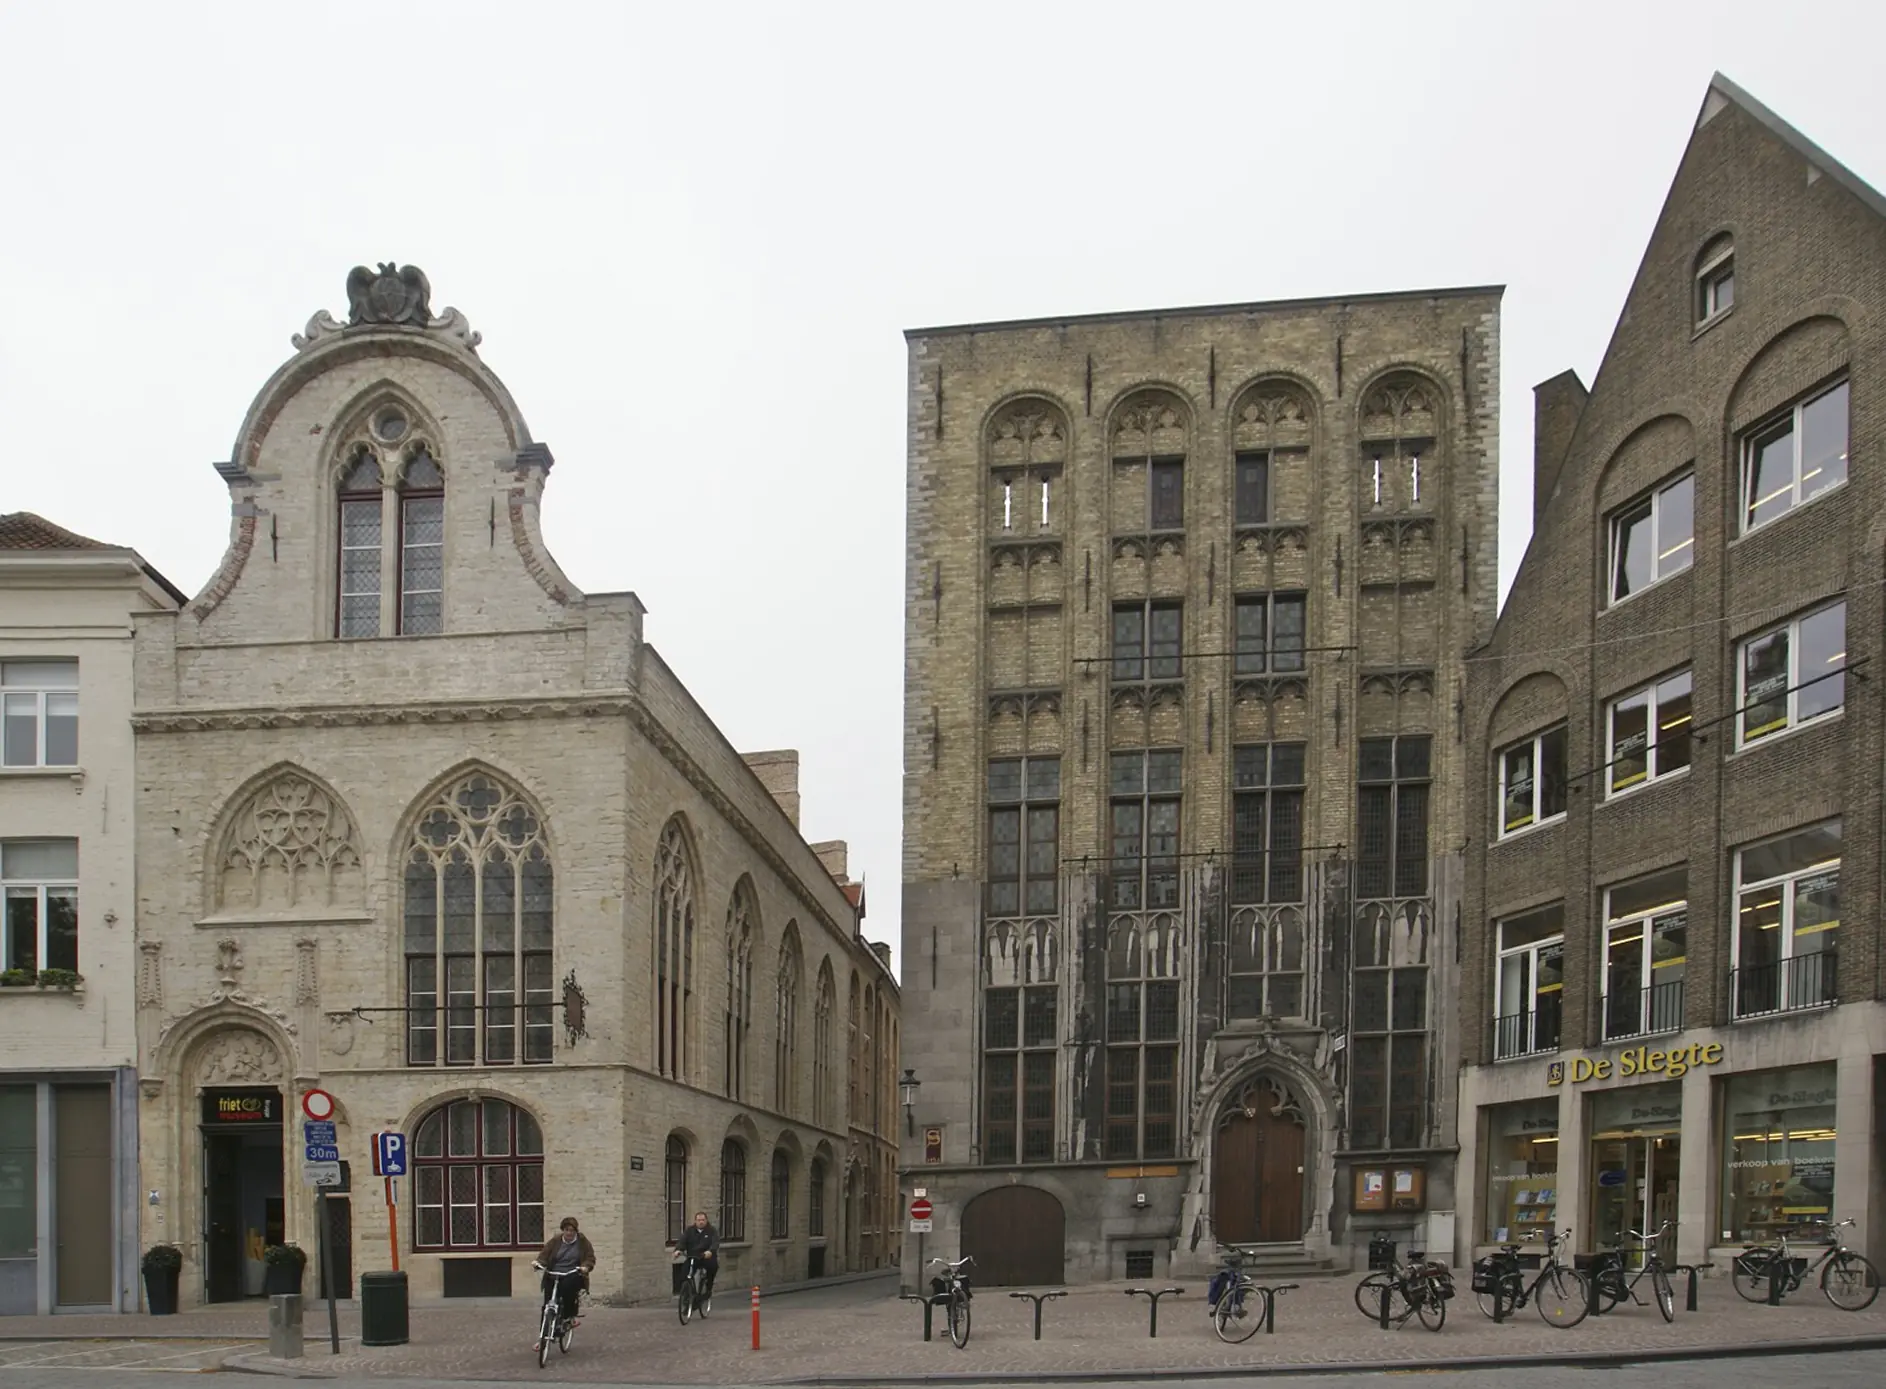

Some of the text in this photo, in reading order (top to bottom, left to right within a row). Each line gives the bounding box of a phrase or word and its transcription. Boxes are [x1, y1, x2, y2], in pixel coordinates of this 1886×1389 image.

[1571, 1041, 1726, 1083] De Slegte
[219, 1096, 241, 1111] friet
[386, 1135, 401, 1159] P
[1728, 1160, 1768, 1169] verkoop
[1771, 1158, 1790, 1166] van
